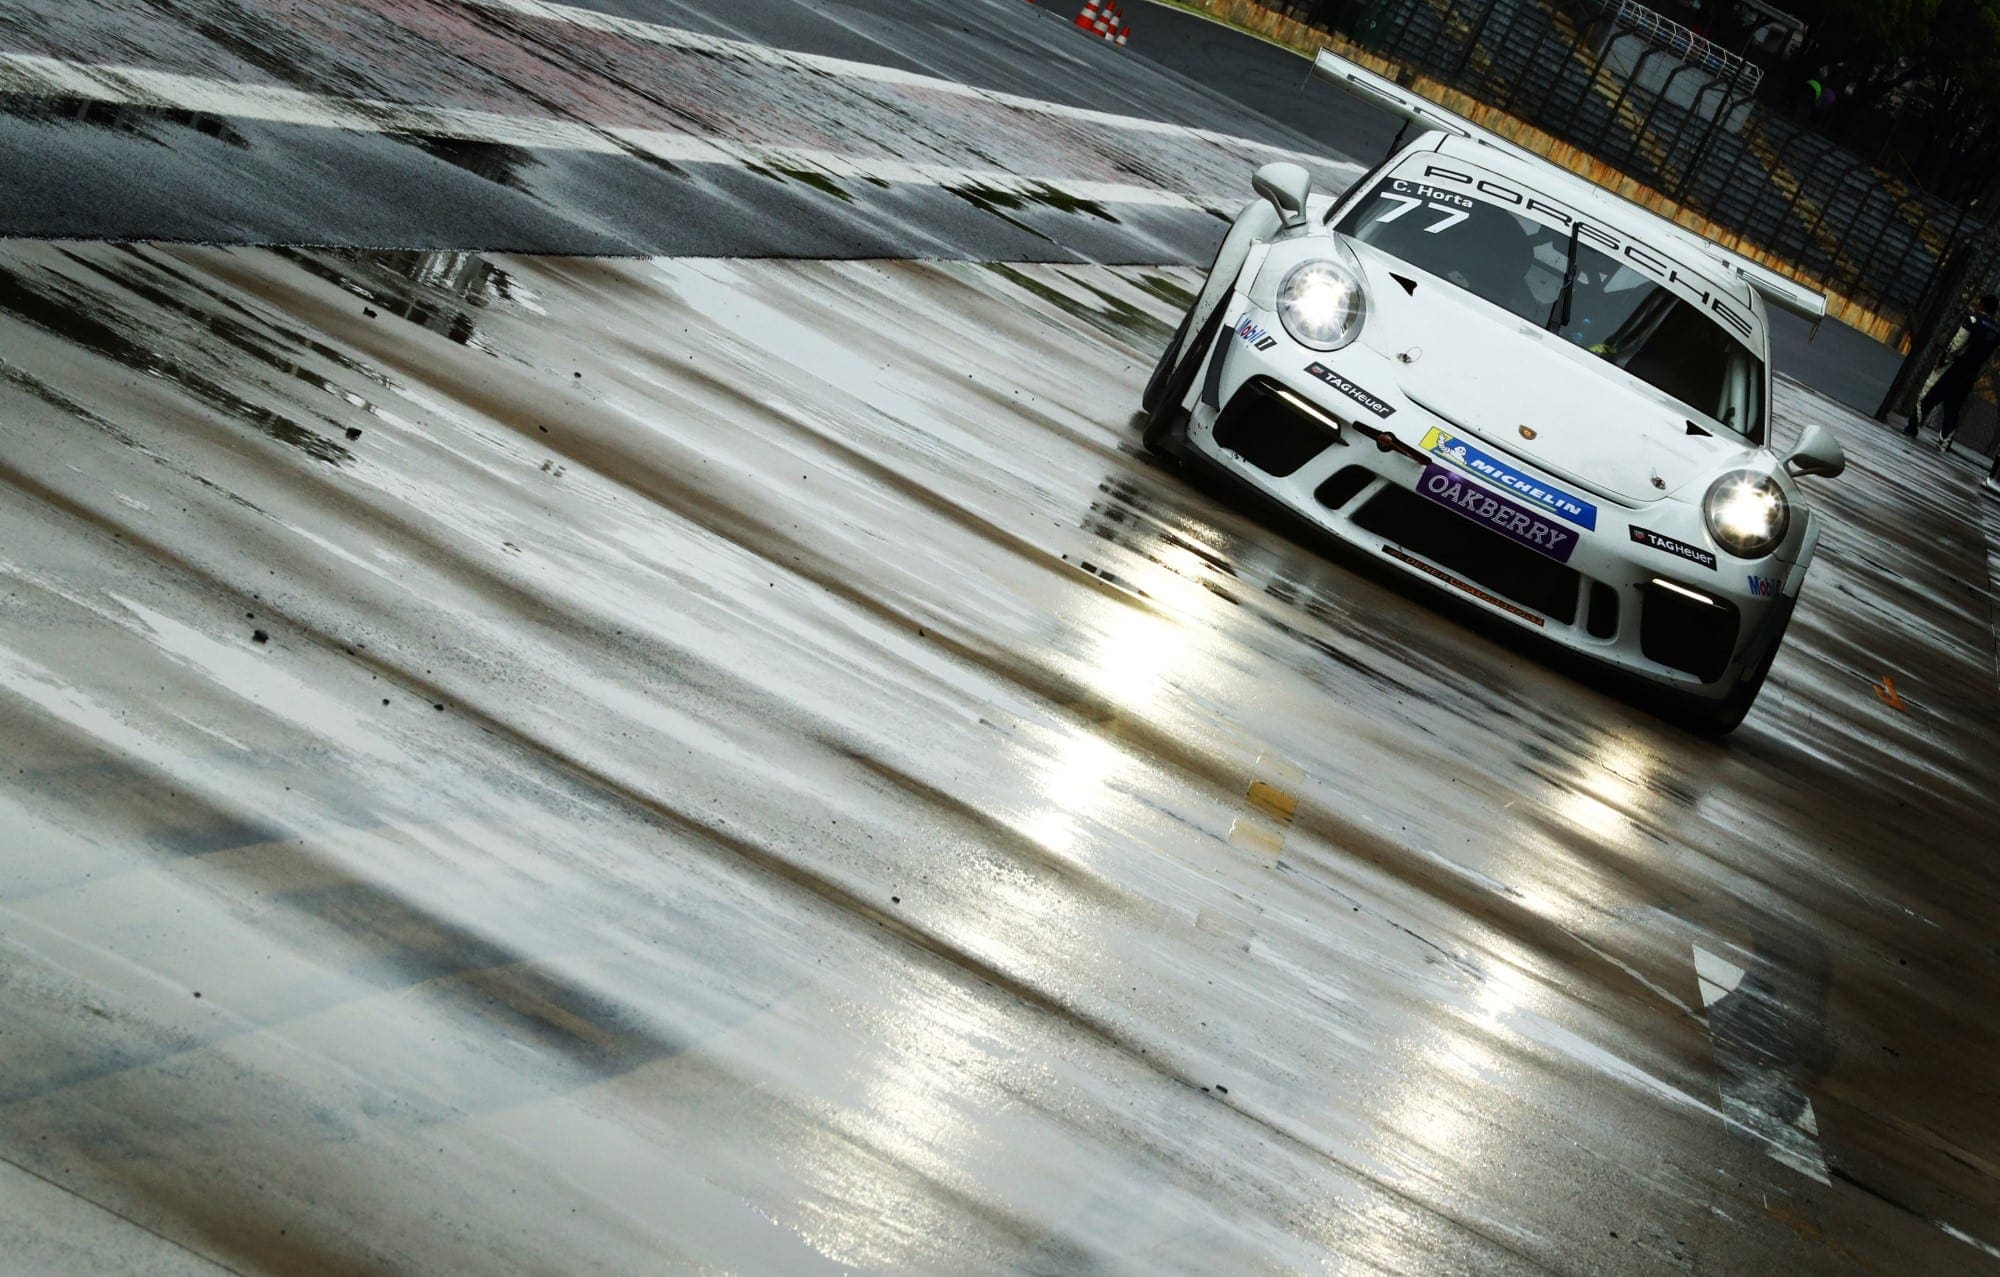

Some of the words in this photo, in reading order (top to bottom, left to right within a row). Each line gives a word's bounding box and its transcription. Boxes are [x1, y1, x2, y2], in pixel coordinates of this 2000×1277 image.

[1376, 191, 1470, 234] 77
[1393, 180, 1412, 193] C.
[1417, 185, 1473, 208] Horta
[1424, 165, 1752, 338] PORSCHE
[1238, 318, 1266, 344] Mobil
[1471, 459, 1582, 515] MICHELIN
[1428, 474, 1567, 550] OAKBERRY
